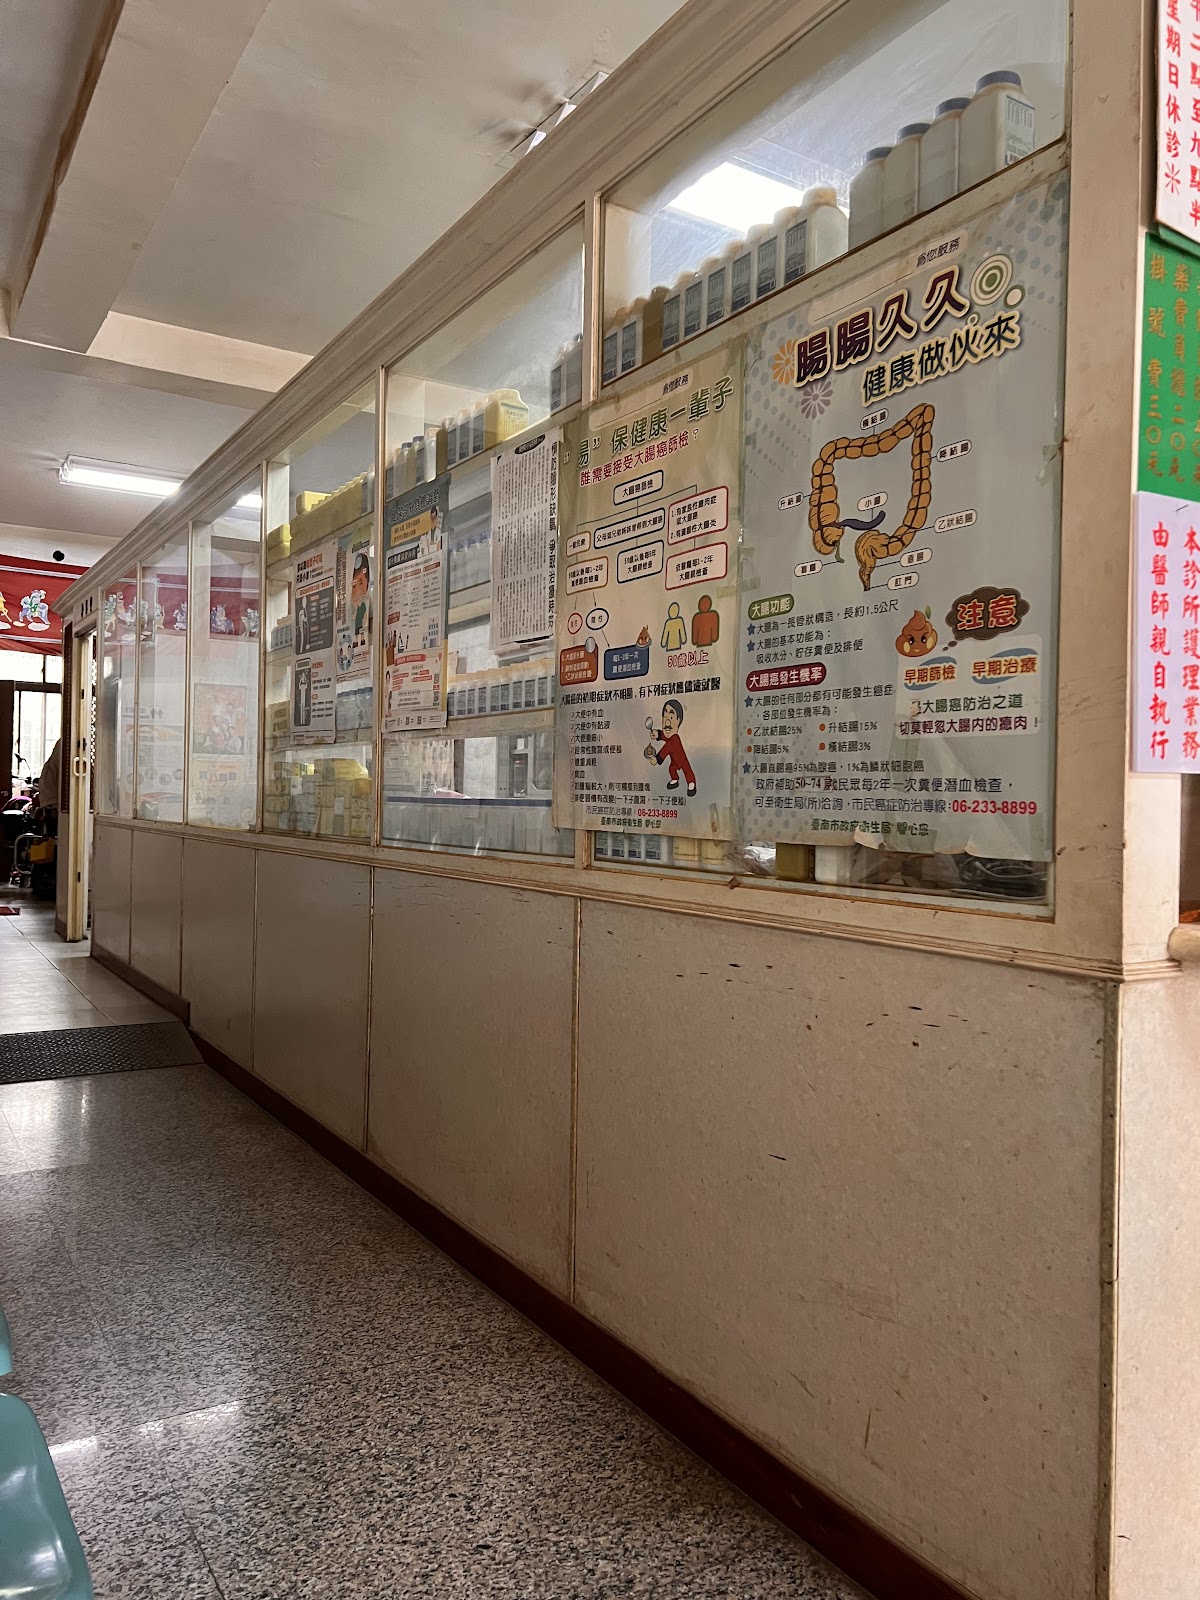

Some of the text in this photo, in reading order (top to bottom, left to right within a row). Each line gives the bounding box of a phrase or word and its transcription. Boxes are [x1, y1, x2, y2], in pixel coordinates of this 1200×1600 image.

[796, 270, 967, 384] 腸腸久久
[863, 315, 1016, 402] 健康做伙來
[611, 375, 733, 456] 保健康一輩子
[752, 597, 790, 618] 大腸功能
[958, 595, 1018, 630] 注意
[1149, 520, 1171, 760] 由醫師親自執行
[1182, 525, 1200, 760] 本診所護理業務
[749, 667, 823, 689] 大腸癌發生機率
[972, 657, 1037, 677] 早期治療
[753, 721, 878, 737] 乙狀結腸25% 升結腸15%
[753, 744, 789, 755] 降結腸5%
